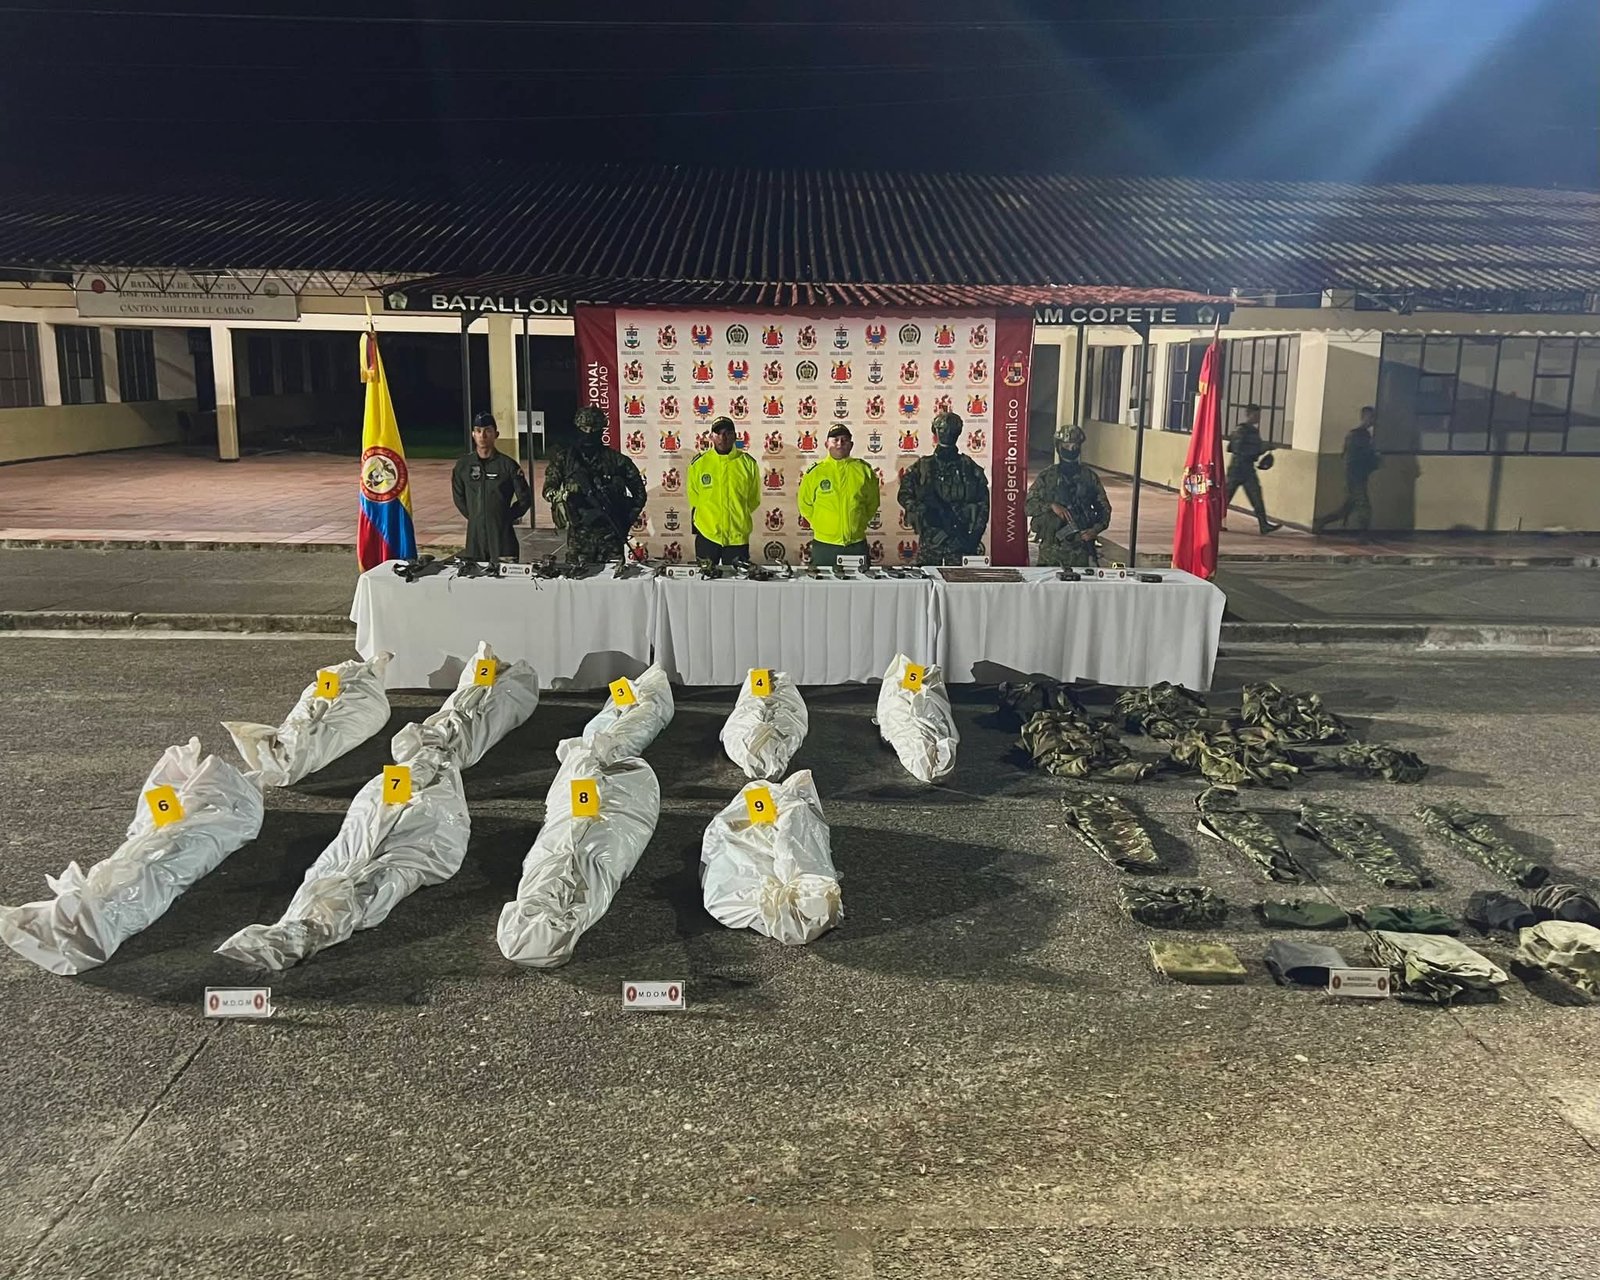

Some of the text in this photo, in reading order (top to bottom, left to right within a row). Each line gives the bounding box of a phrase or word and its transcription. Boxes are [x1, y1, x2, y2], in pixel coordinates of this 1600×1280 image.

[161, 305, 200, 313] MILITAR
[432, 295, 568, 314] BATALLÓN
[1070, 307, 1177, 323] COPETE
[599, 366, 609, 410] LEALTAD
[1004, 399, 1019, 543] www.ejercito.mil.co
[480, 667, 488, 676] 2
[909, 672, 917, 681] 5
[755, 679, 763, 687] 4
[617, 688, 625, 697] 3
[391, 779, 401, 790] 7
[579, 792, 589, 803] 8
[158, 800, 169, 811] 6
[754, 800, 764, 811] 9
